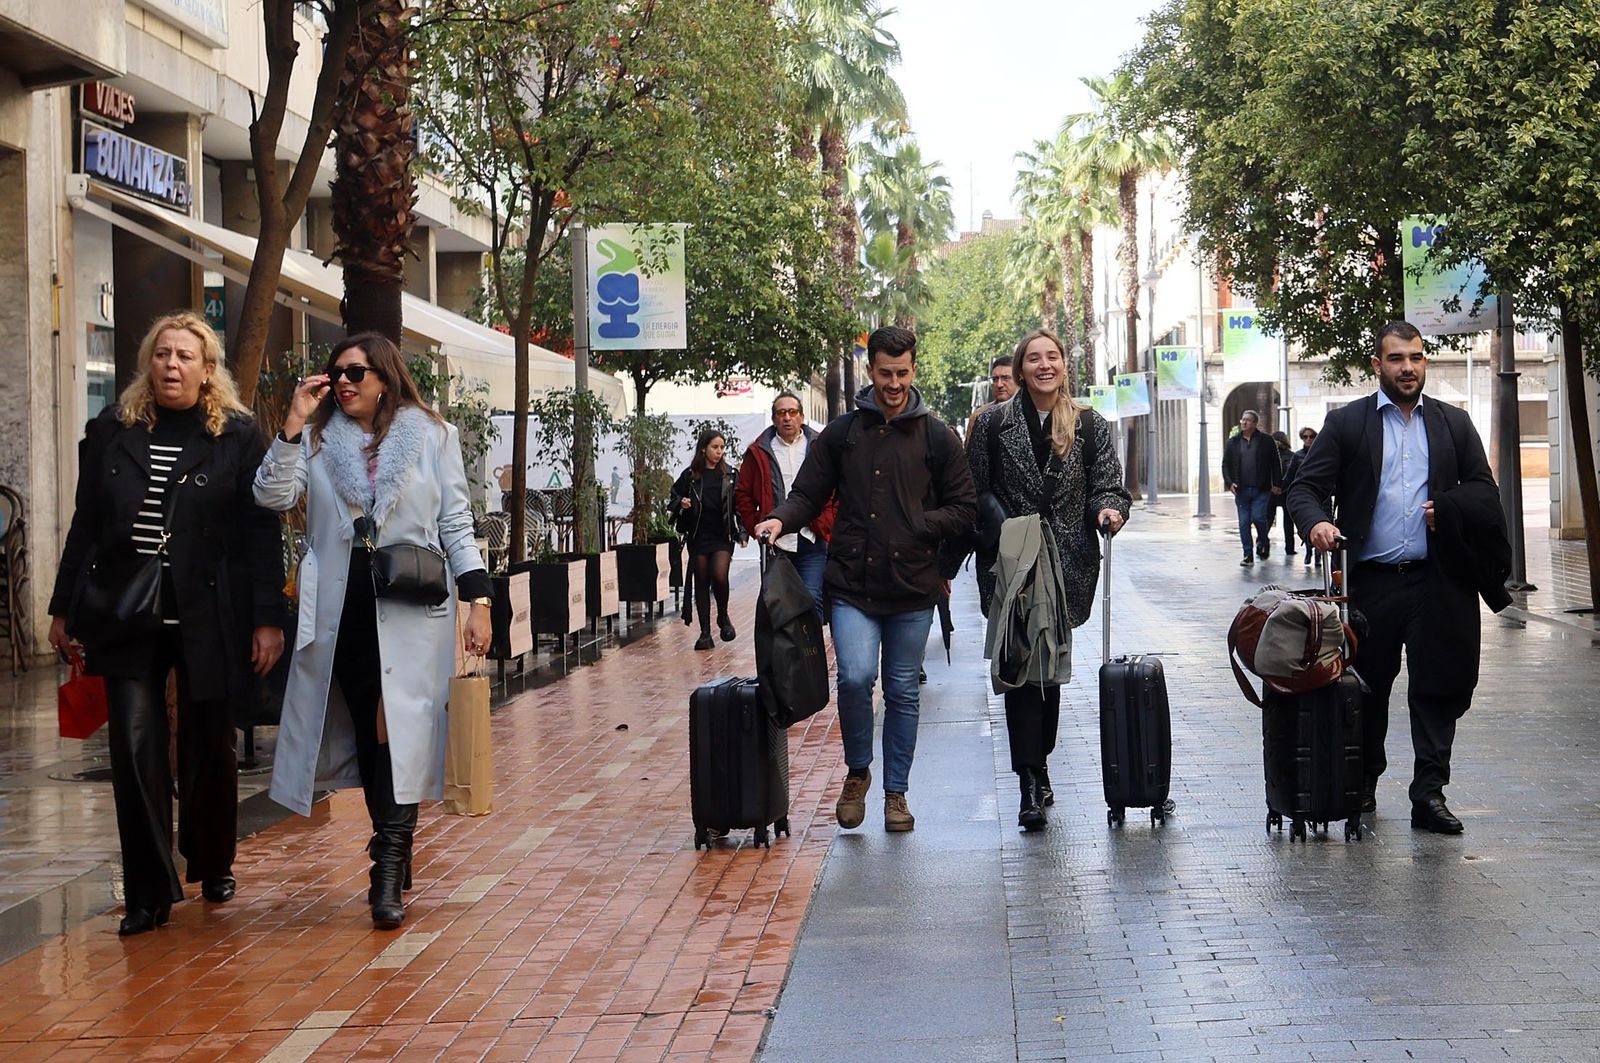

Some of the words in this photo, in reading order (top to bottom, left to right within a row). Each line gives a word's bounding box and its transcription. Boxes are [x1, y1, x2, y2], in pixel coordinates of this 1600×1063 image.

[96, 80, 135, 124] VIAJES
[1229, 315, 1253, 329] H2
[1161, 351, 1178, 361] H2
